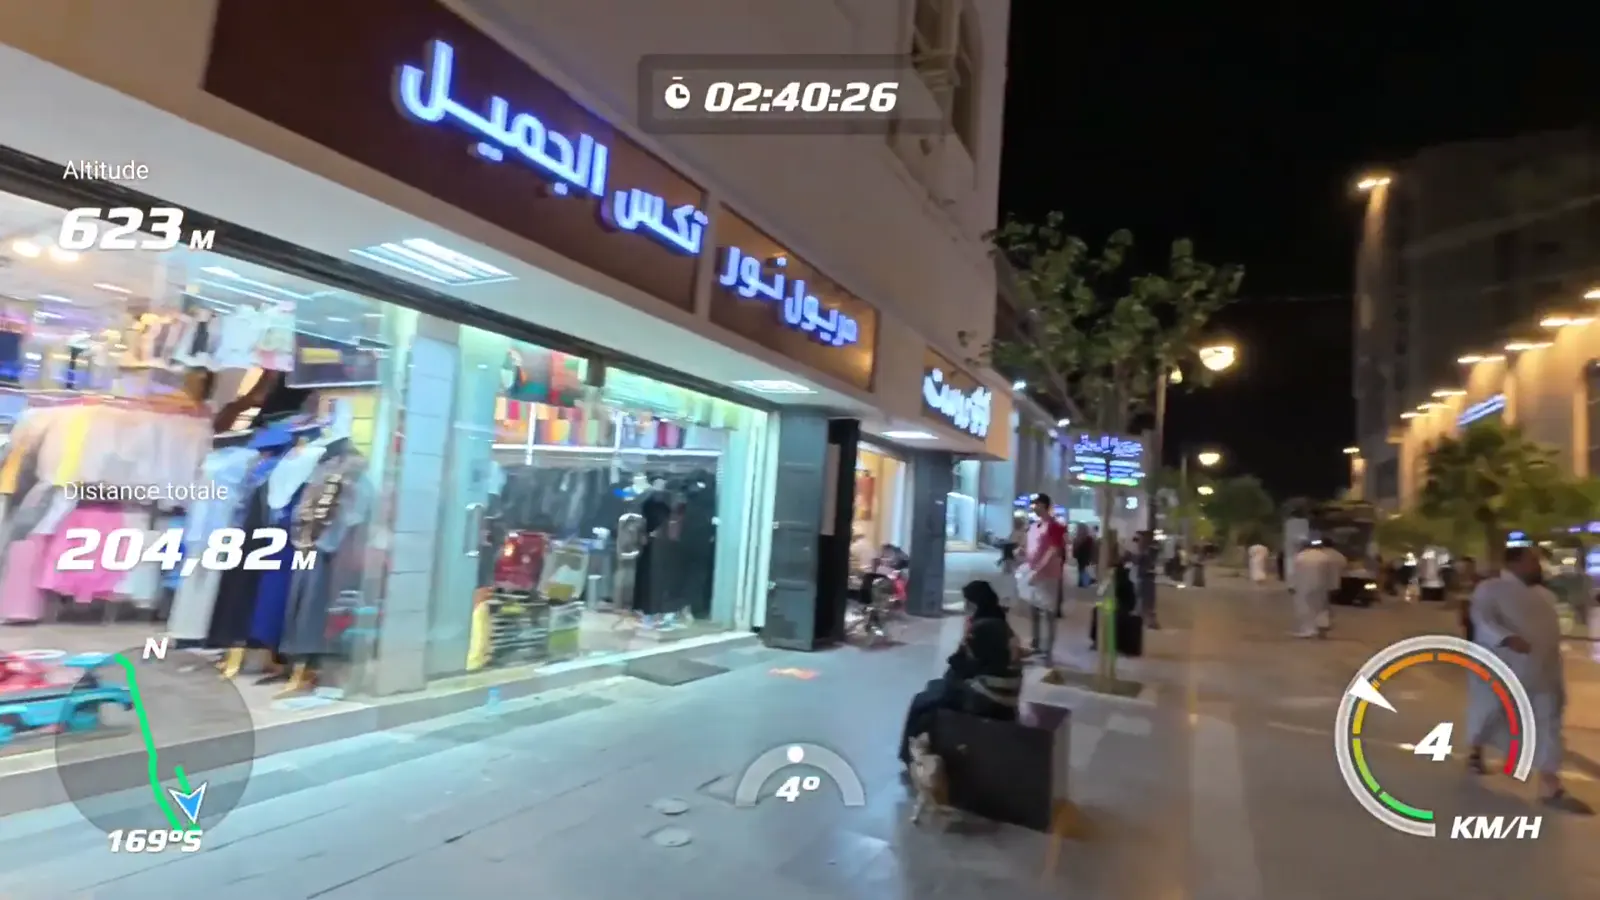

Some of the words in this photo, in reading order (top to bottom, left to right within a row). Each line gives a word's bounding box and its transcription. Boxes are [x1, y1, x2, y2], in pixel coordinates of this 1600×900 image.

[398, 38, 609, 197] الجميل
[719, 245, 787, 300] نور
[783, 279, 858, 346] مريول
